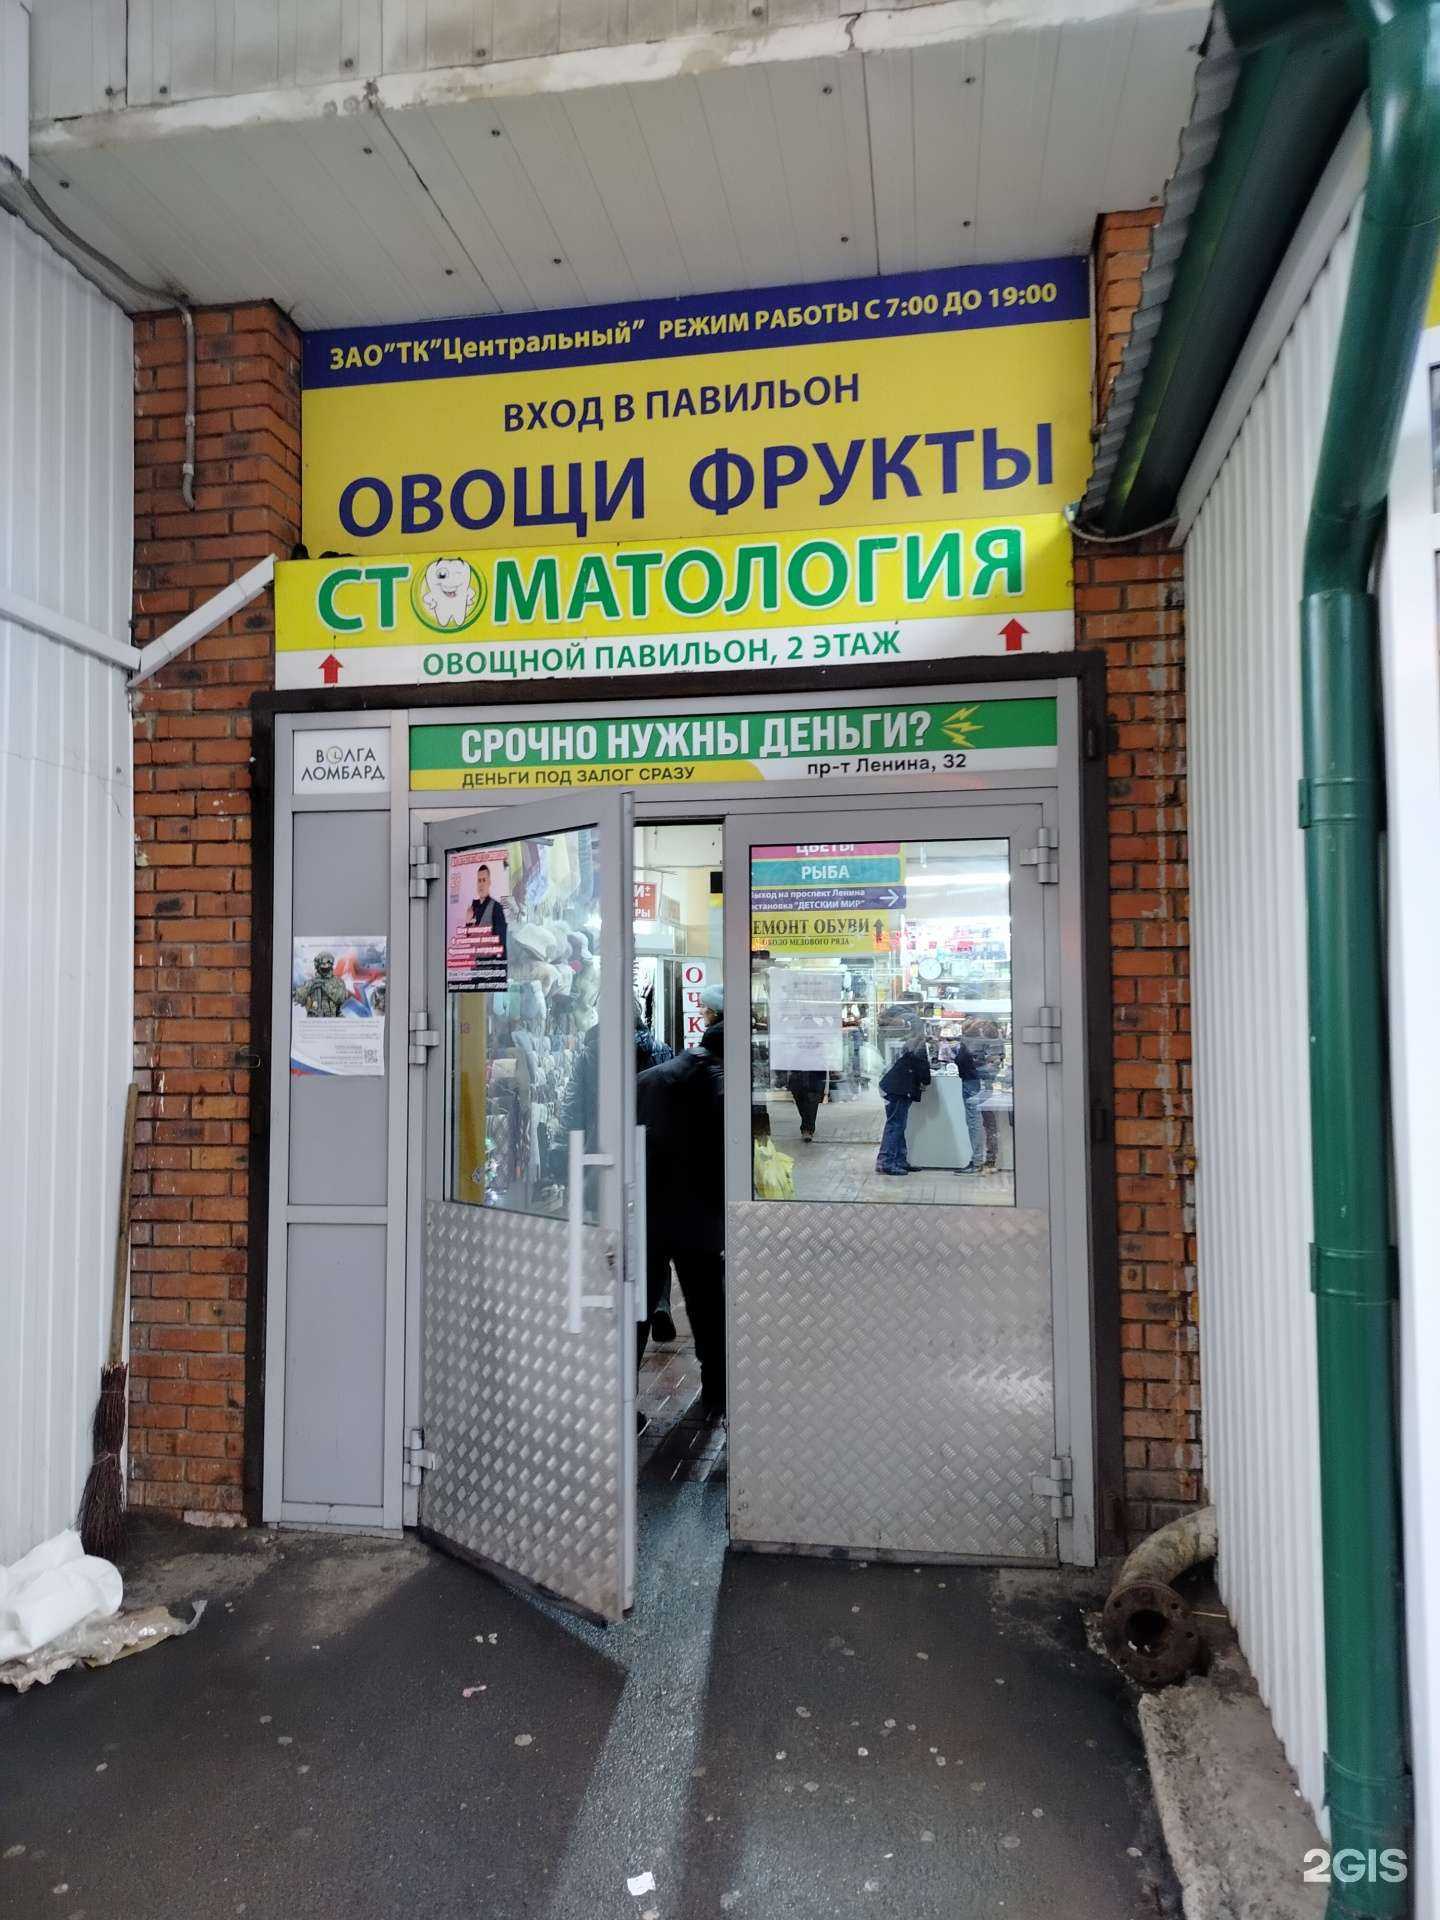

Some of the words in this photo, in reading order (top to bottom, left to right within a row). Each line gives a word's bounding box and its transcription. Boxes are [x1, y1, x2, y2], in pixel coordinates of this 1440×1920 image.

[658, 311, 751, 341] РЕЖИМ
[754, 300, 859, 331] РАБОТЫ
[867, 298, 881, 320] С
[885, 294, 939, 318] 7:00
[942, 288, 983, 317] ДО
[987, 282, 1058, 308] 19:00
[503, 396, 605, 433] ВХОД
[613, 392, 636, 423] В
[646, 373, 860, 421] ПАВИЛЬОН
[338, 456, 646, 539] ОВОЩИ
[688, 422, 1054, 517] ФРУКТЫ
[315, 526, 1025, 634] СТОМАТОЛОГИЯ
[422, 641, 586, 678] ОВОЩНОЙ
[594, 638, 778, 671] ПАВИЛЬОН,
[786, 635, 804, 661] 2
[812, 630, 901, 659] ЭТАЖ
[460, 724, 598, 765] СРОЧНО
[607, 718, 750, 761] НУЖНЫ
[758, 710, 933, 759] ДЕНЬГИ?
[315, 745, 377, 765] ВОЛГА
[807, 759, 850, 779] пр-т
[855, 756, 937, 774] Ленина,
[942, 753, 967, 769] 32
[300, 765, 386, 784] ЛОМБАРД
[461, 771, 530, 789] ДЕНЬГИ
[535, 770, 573, 787] ПОД
[579, 767, 634, 784] ЗАЛОГ
[638, 765, 695, 782] СРАЗУ
[801, 864, 851, 880] РЫБА
[778, 890, 789, 899] на
[790, 890, 832, 900] проспект
[832, 888, 866, 897] Ленина
[752, 919, 810, 935] ЕМОНТ
[813, 918, 870, 934] ОБУВИ
